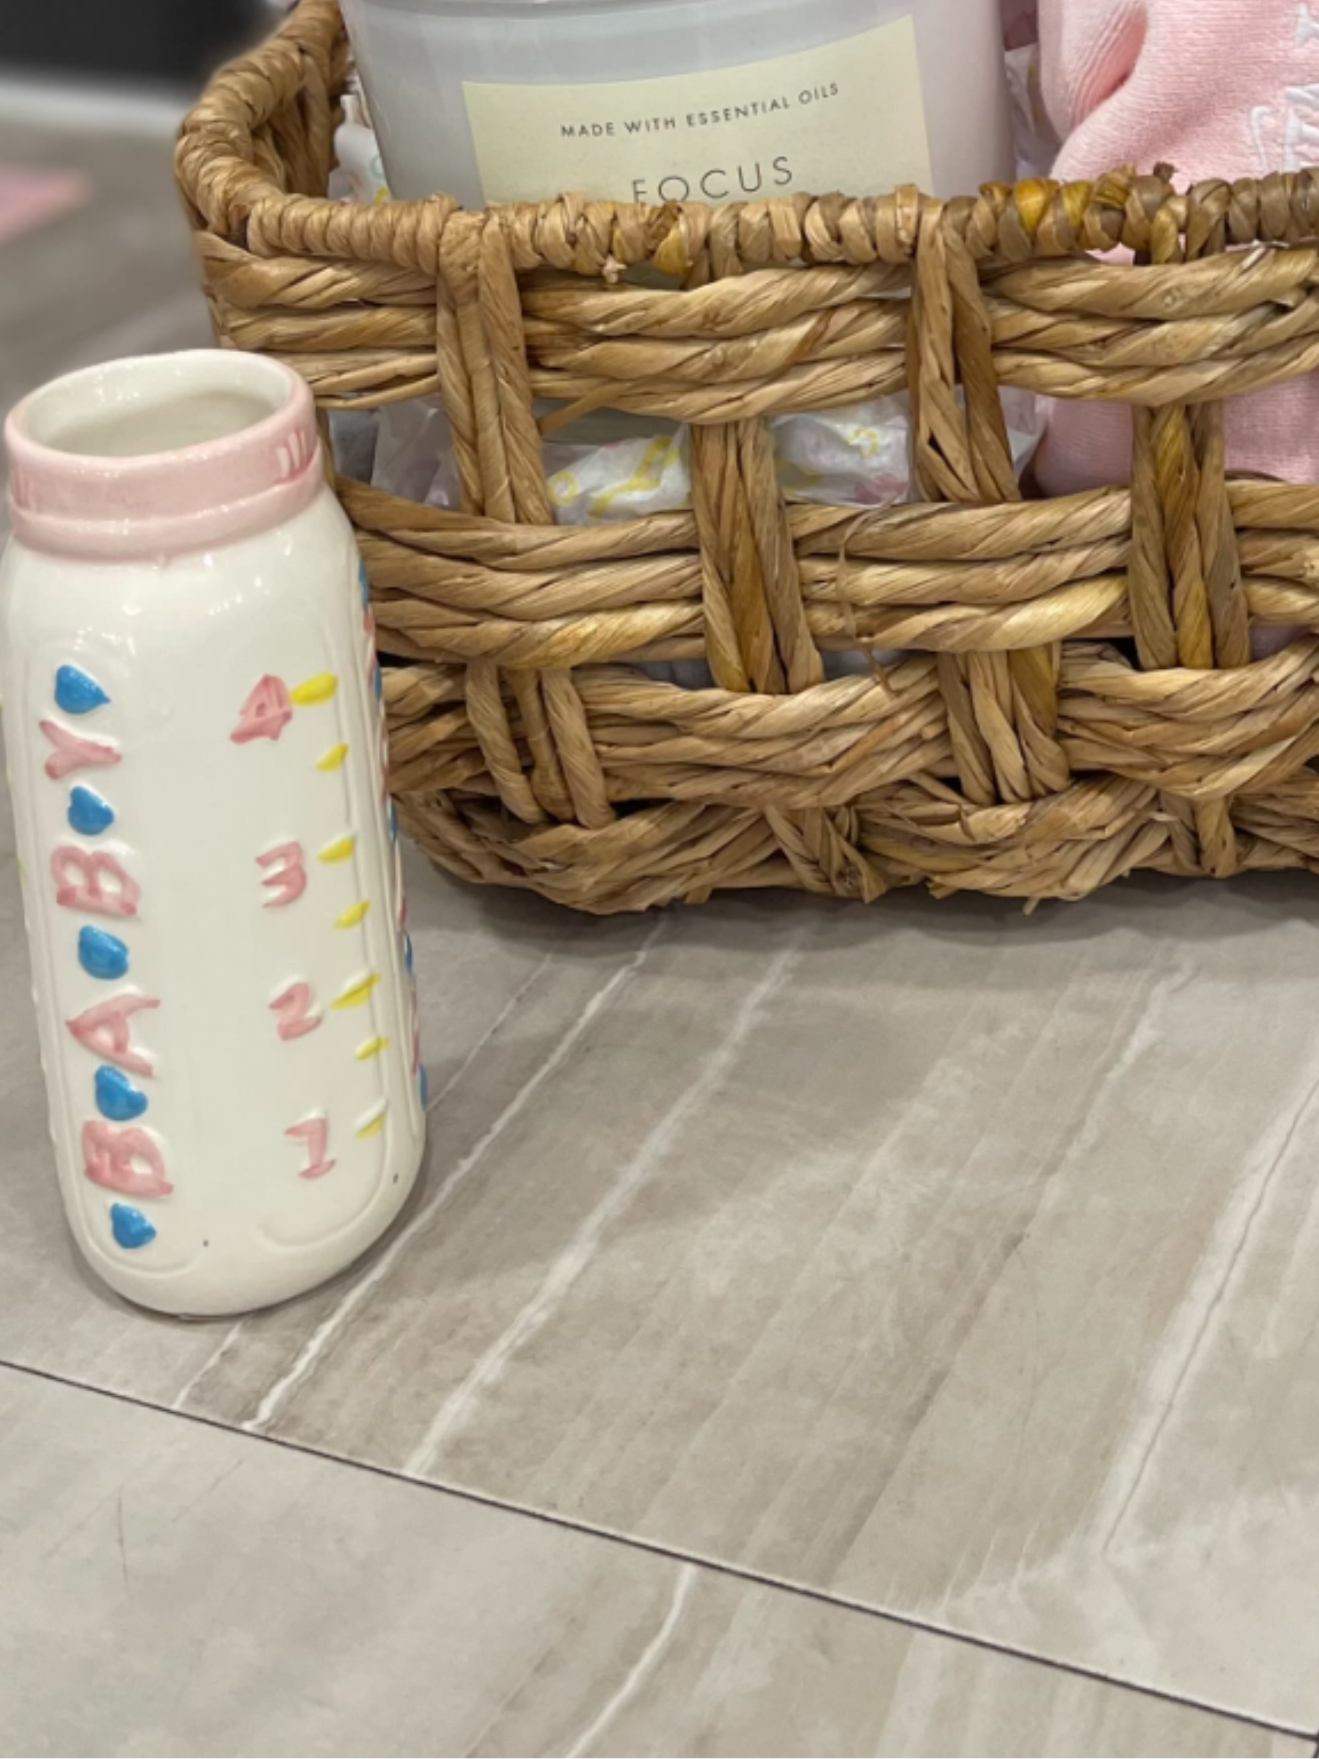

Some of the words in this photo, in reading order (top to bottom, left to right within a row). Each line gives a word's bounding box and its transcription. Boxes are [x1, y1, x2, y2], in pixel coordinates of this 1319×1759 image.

[560, 121, 615, 138] MADE
[624, 116, 676, 134] WITH
[686, 96, 790, 127] ESSENTIAL
[798, 82, 839, 105] OILS
[632, 155, 793, 203] FOCUS
[229, 673, 293, 744] 4
[255, 841, 307, 908] 3
[268, 981, 322, 1041] 2
[284, 1115, 337, 1180] 1
